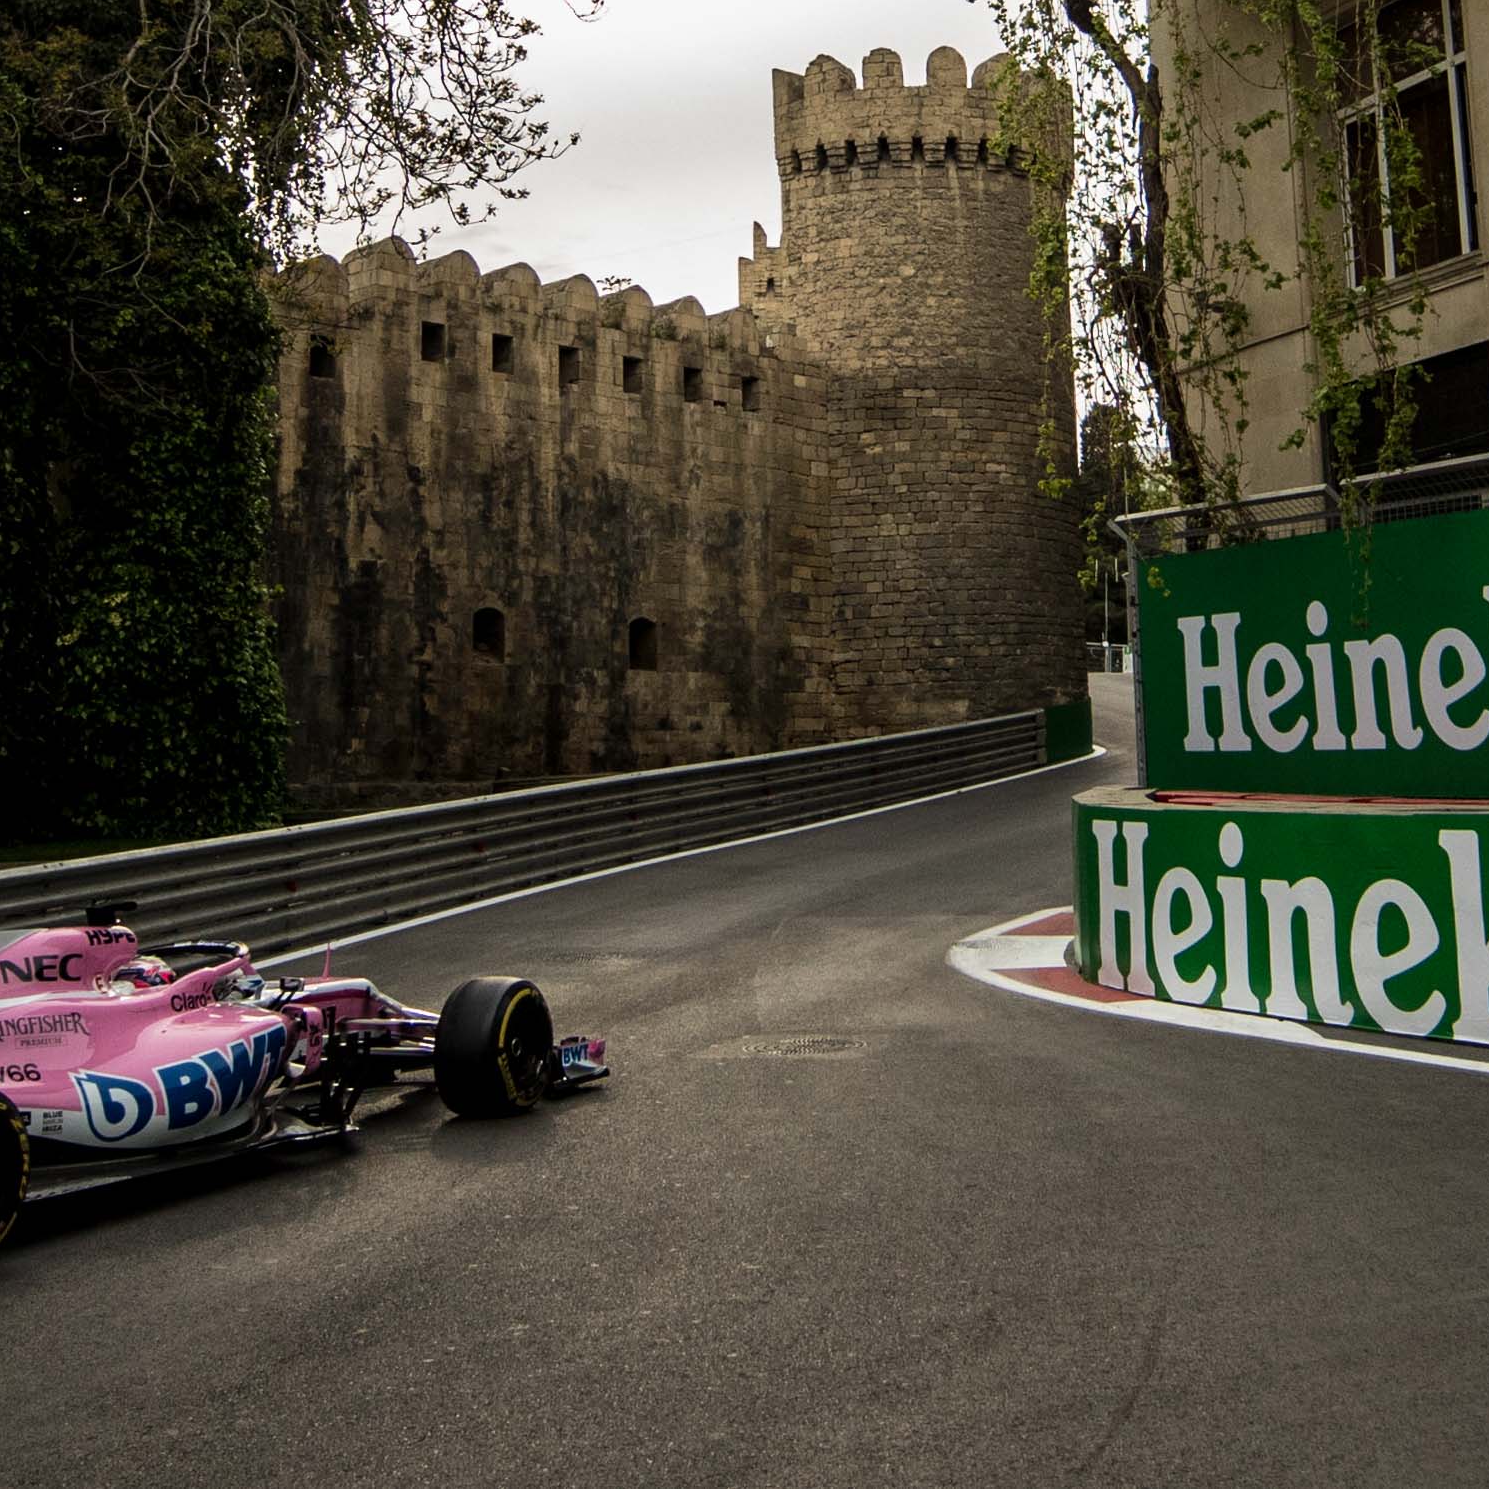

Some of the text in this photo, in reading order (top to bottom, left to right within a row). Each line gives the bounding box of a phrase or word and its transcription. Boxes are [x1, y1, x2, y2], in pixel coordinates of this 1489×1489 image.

[85, 929, 136, 947] HYPE
[171, 991, 208, 1012] Claro
[563, 1044, 589, 1064] BWT
[156, 1024, 287, 1131] BWT
